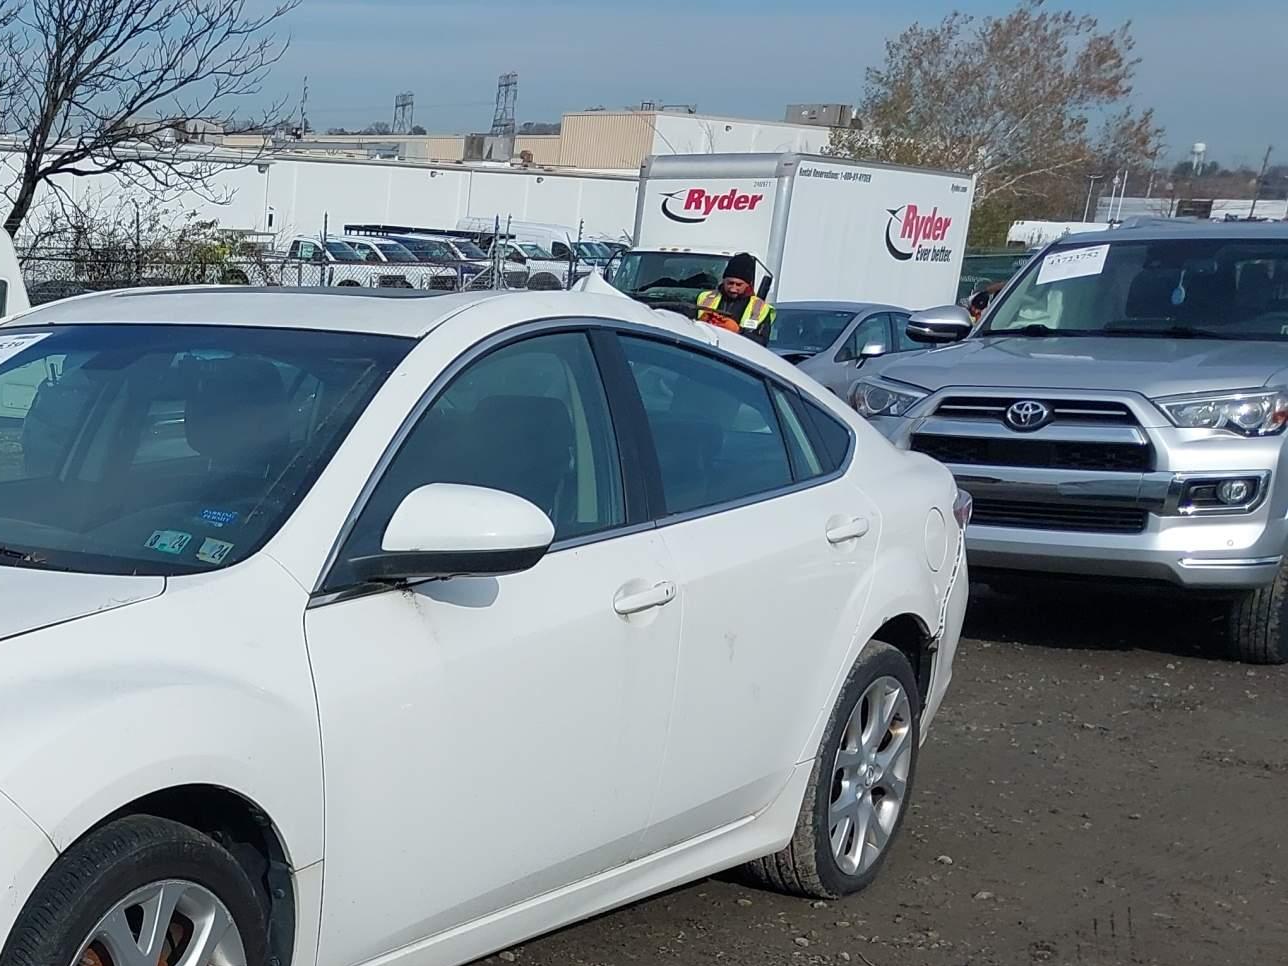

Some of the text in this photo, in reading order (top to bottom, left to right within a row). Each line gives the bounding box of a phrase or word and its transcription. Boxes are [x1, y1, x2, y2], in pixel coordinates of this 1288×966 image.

[683, 189, 763, 216] Ryder
[900, 204, 952, 248] Ryder
[915, 244, 952, 263] Ever better.
[171, 535, 190, 553] 24
[212, 544, 229, 561] 24
